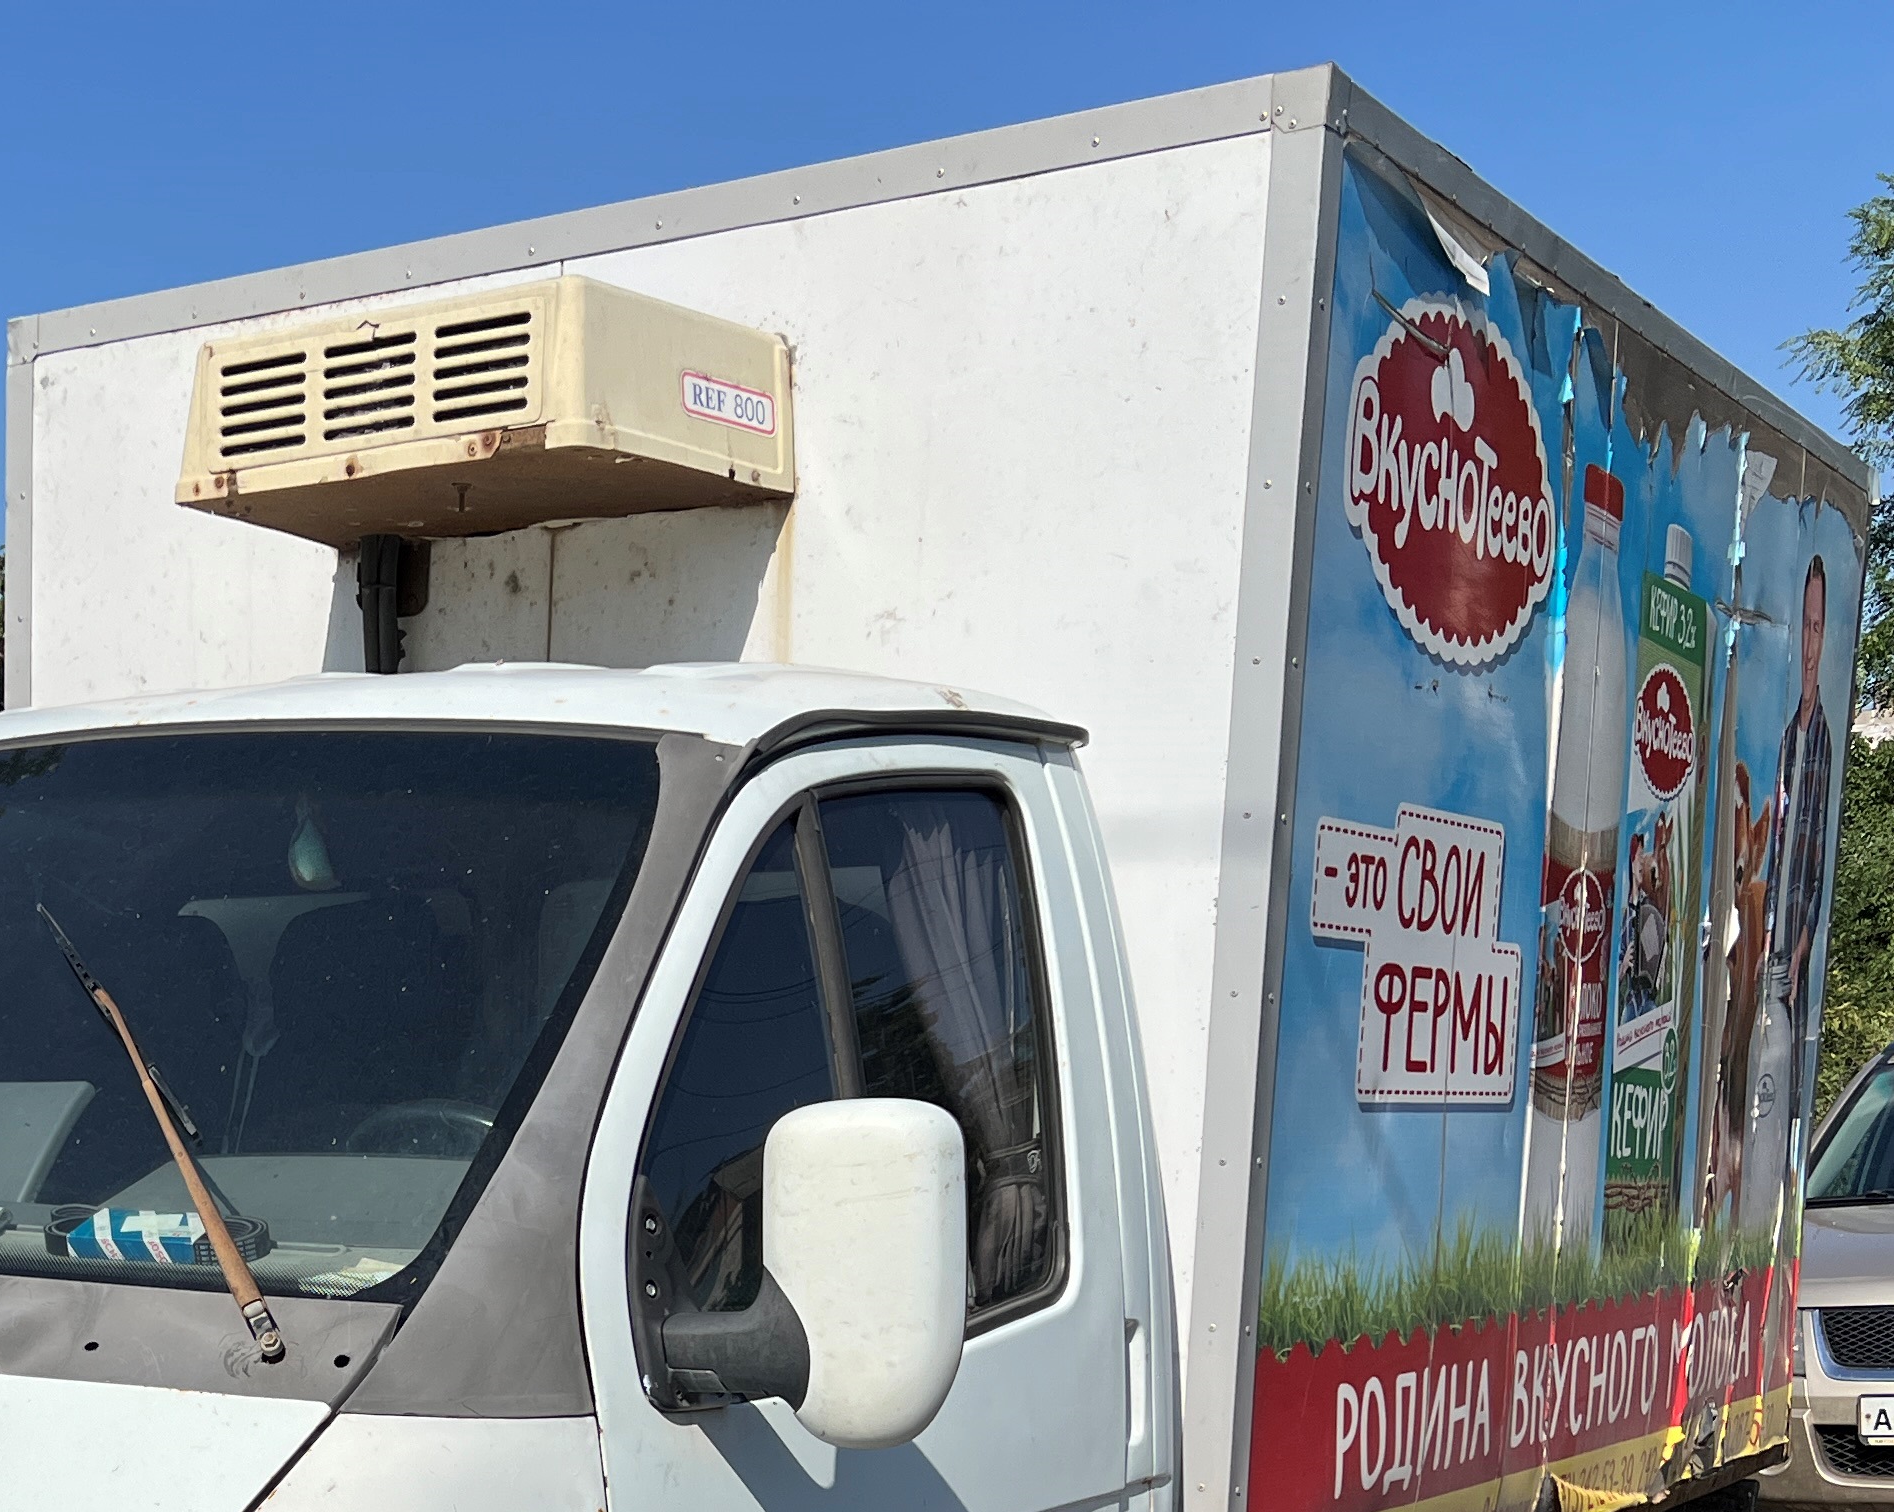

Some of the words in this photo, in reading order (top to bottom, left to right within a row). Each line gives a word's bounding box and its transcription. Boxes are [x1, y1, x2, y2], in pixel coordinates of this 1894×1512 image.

[692, 382, 726, 412] REF
[734, 393, 765, 425] 800
[1650, 584, 1678, 640] КЕФИР
[1397, 835, 1485, 938] СВОИ
[1374, 962, 1508, 1077] ФЕРМЫ
[1610, 1081, 1669, 1160] КЕФИР
[1334, 1357, 1491, 1500] РОДИНА
[1510, 1323, 1657, 1449] ВКУСНОГО
